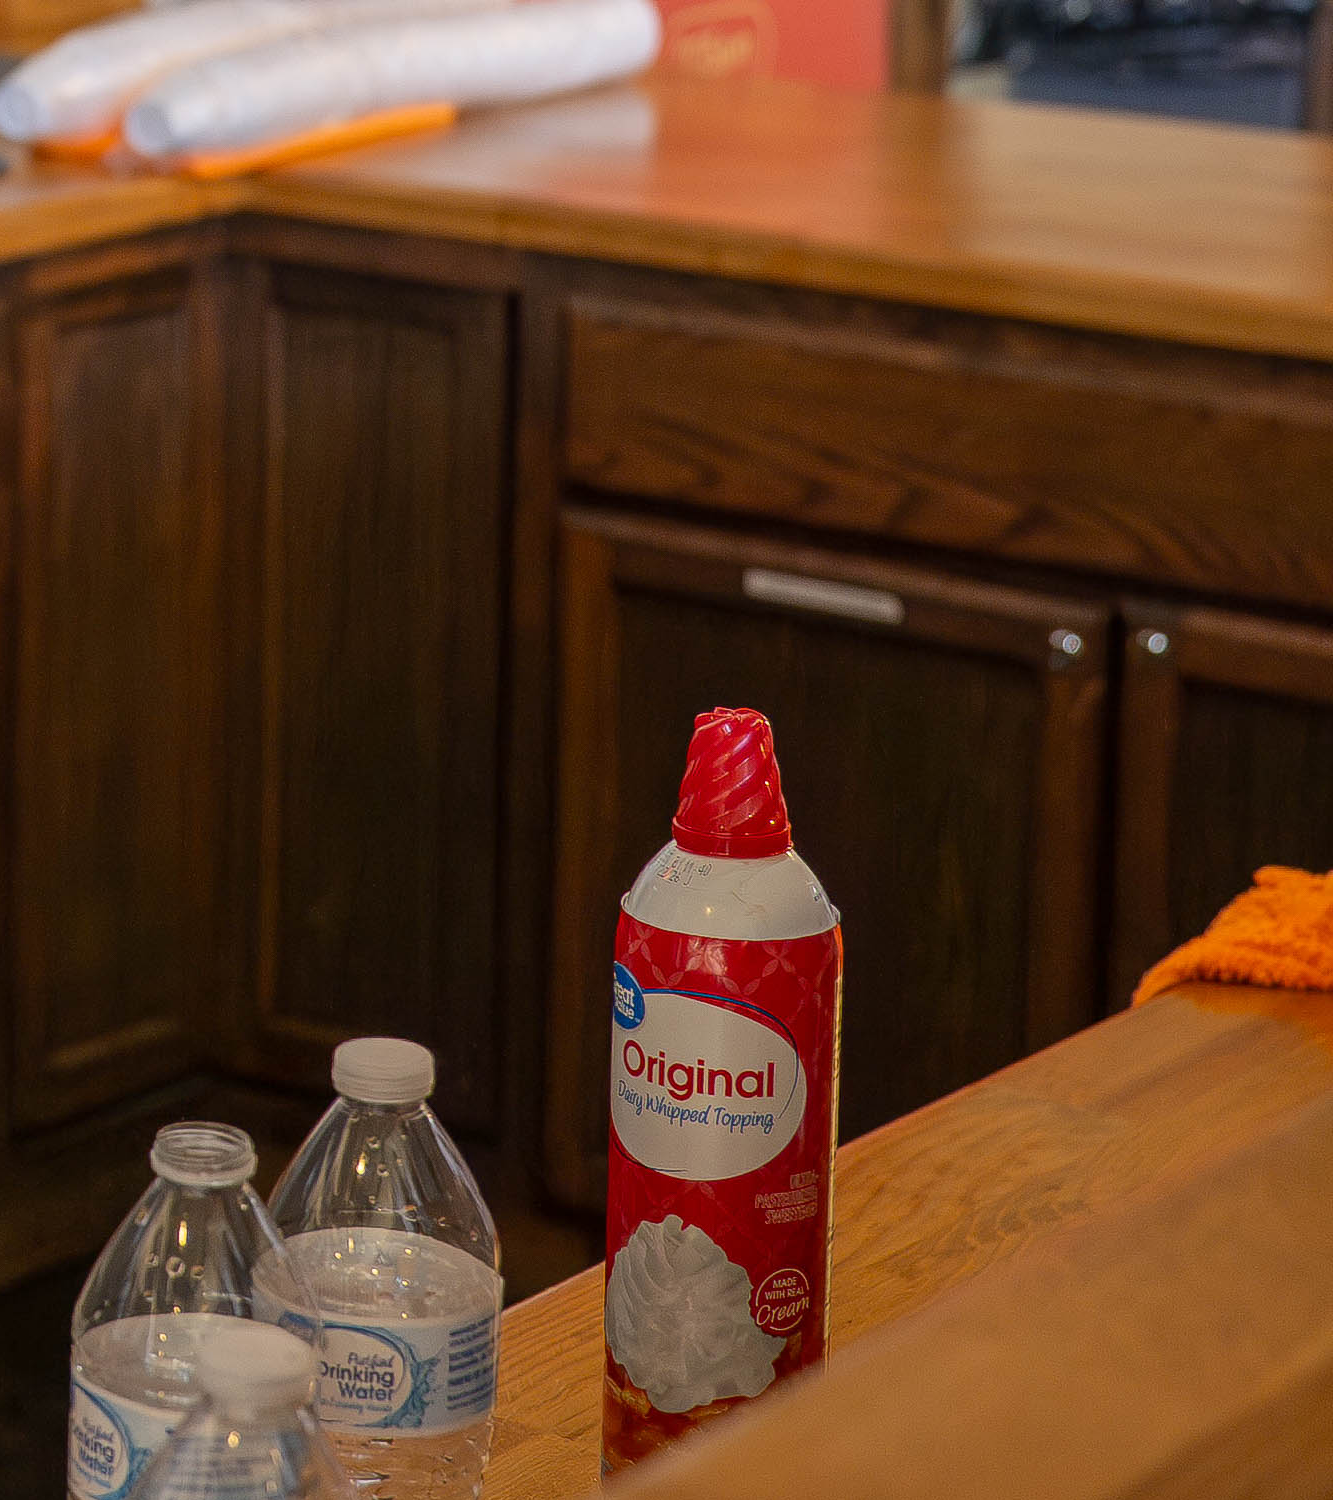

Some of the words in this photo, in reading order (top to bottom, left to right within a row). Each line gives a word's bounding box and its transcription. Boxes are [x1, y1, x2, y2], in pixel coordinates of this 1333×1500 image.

[623, 1039, 775, 1101] Original
[619, 1079, 643, 1116] Dairy
[646, 1093, 710, 1127] Whipped
[714, 1106, 774, 1134] Topping
[765, 1290, 785, 1301] WITH
[773, 1277, 797, 1289] MADE
[756, 1296, 810, 1326] Cream
[339, 1381, 394, 1402] Water
